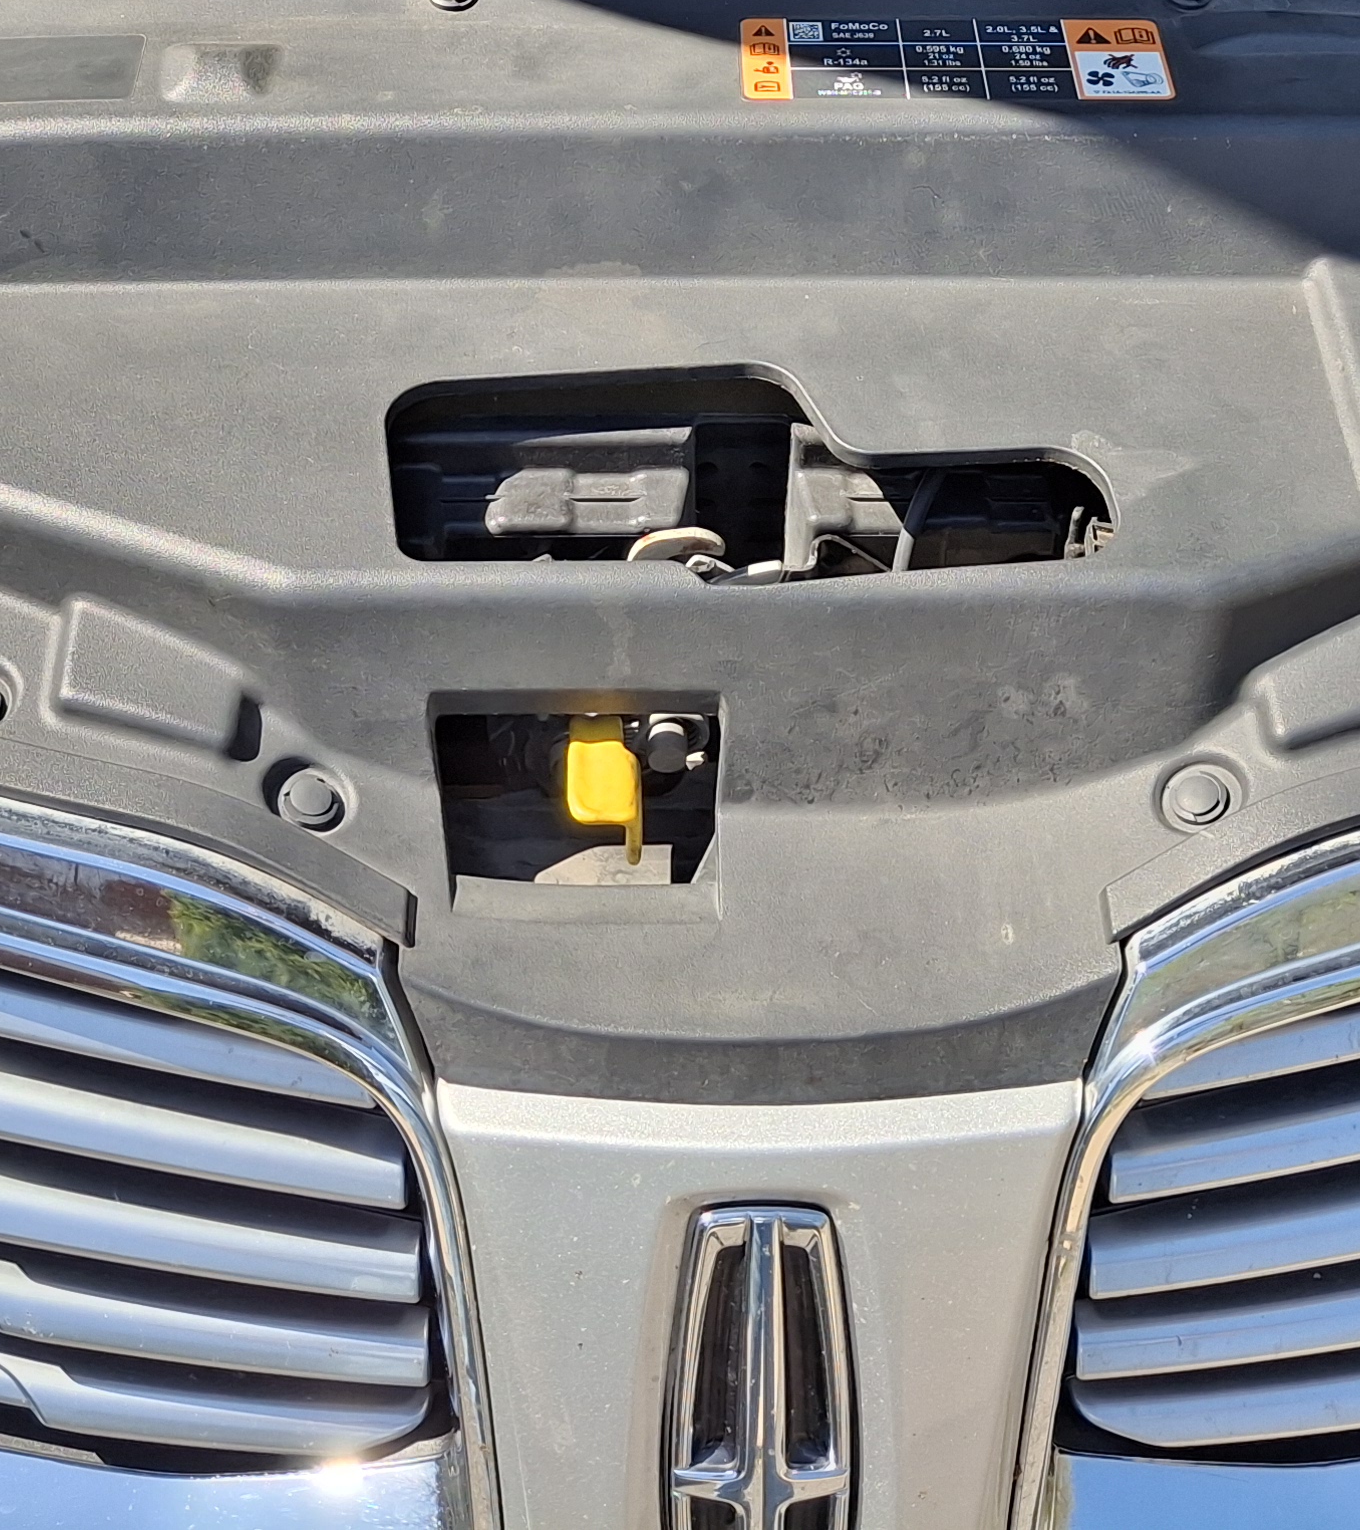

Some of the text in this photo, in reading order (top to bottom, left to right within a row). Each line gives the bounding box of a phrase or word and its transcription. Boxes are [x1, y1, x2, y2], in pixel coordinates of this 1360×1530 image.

[831, 22, 889, 30] FoMoCo
[1048, 25, 1059, 33] &
[923, 29, 950, 37] 2.7L
[949, 45, 964, 54] kg
[1036, 45, 1051, 55] kg
[823, 58, 869, 66] R-134a
[921, 75, 939, 83] 5.2
[942, 75, 950, 83] fl
[834, 82, 864, 90] PAG
